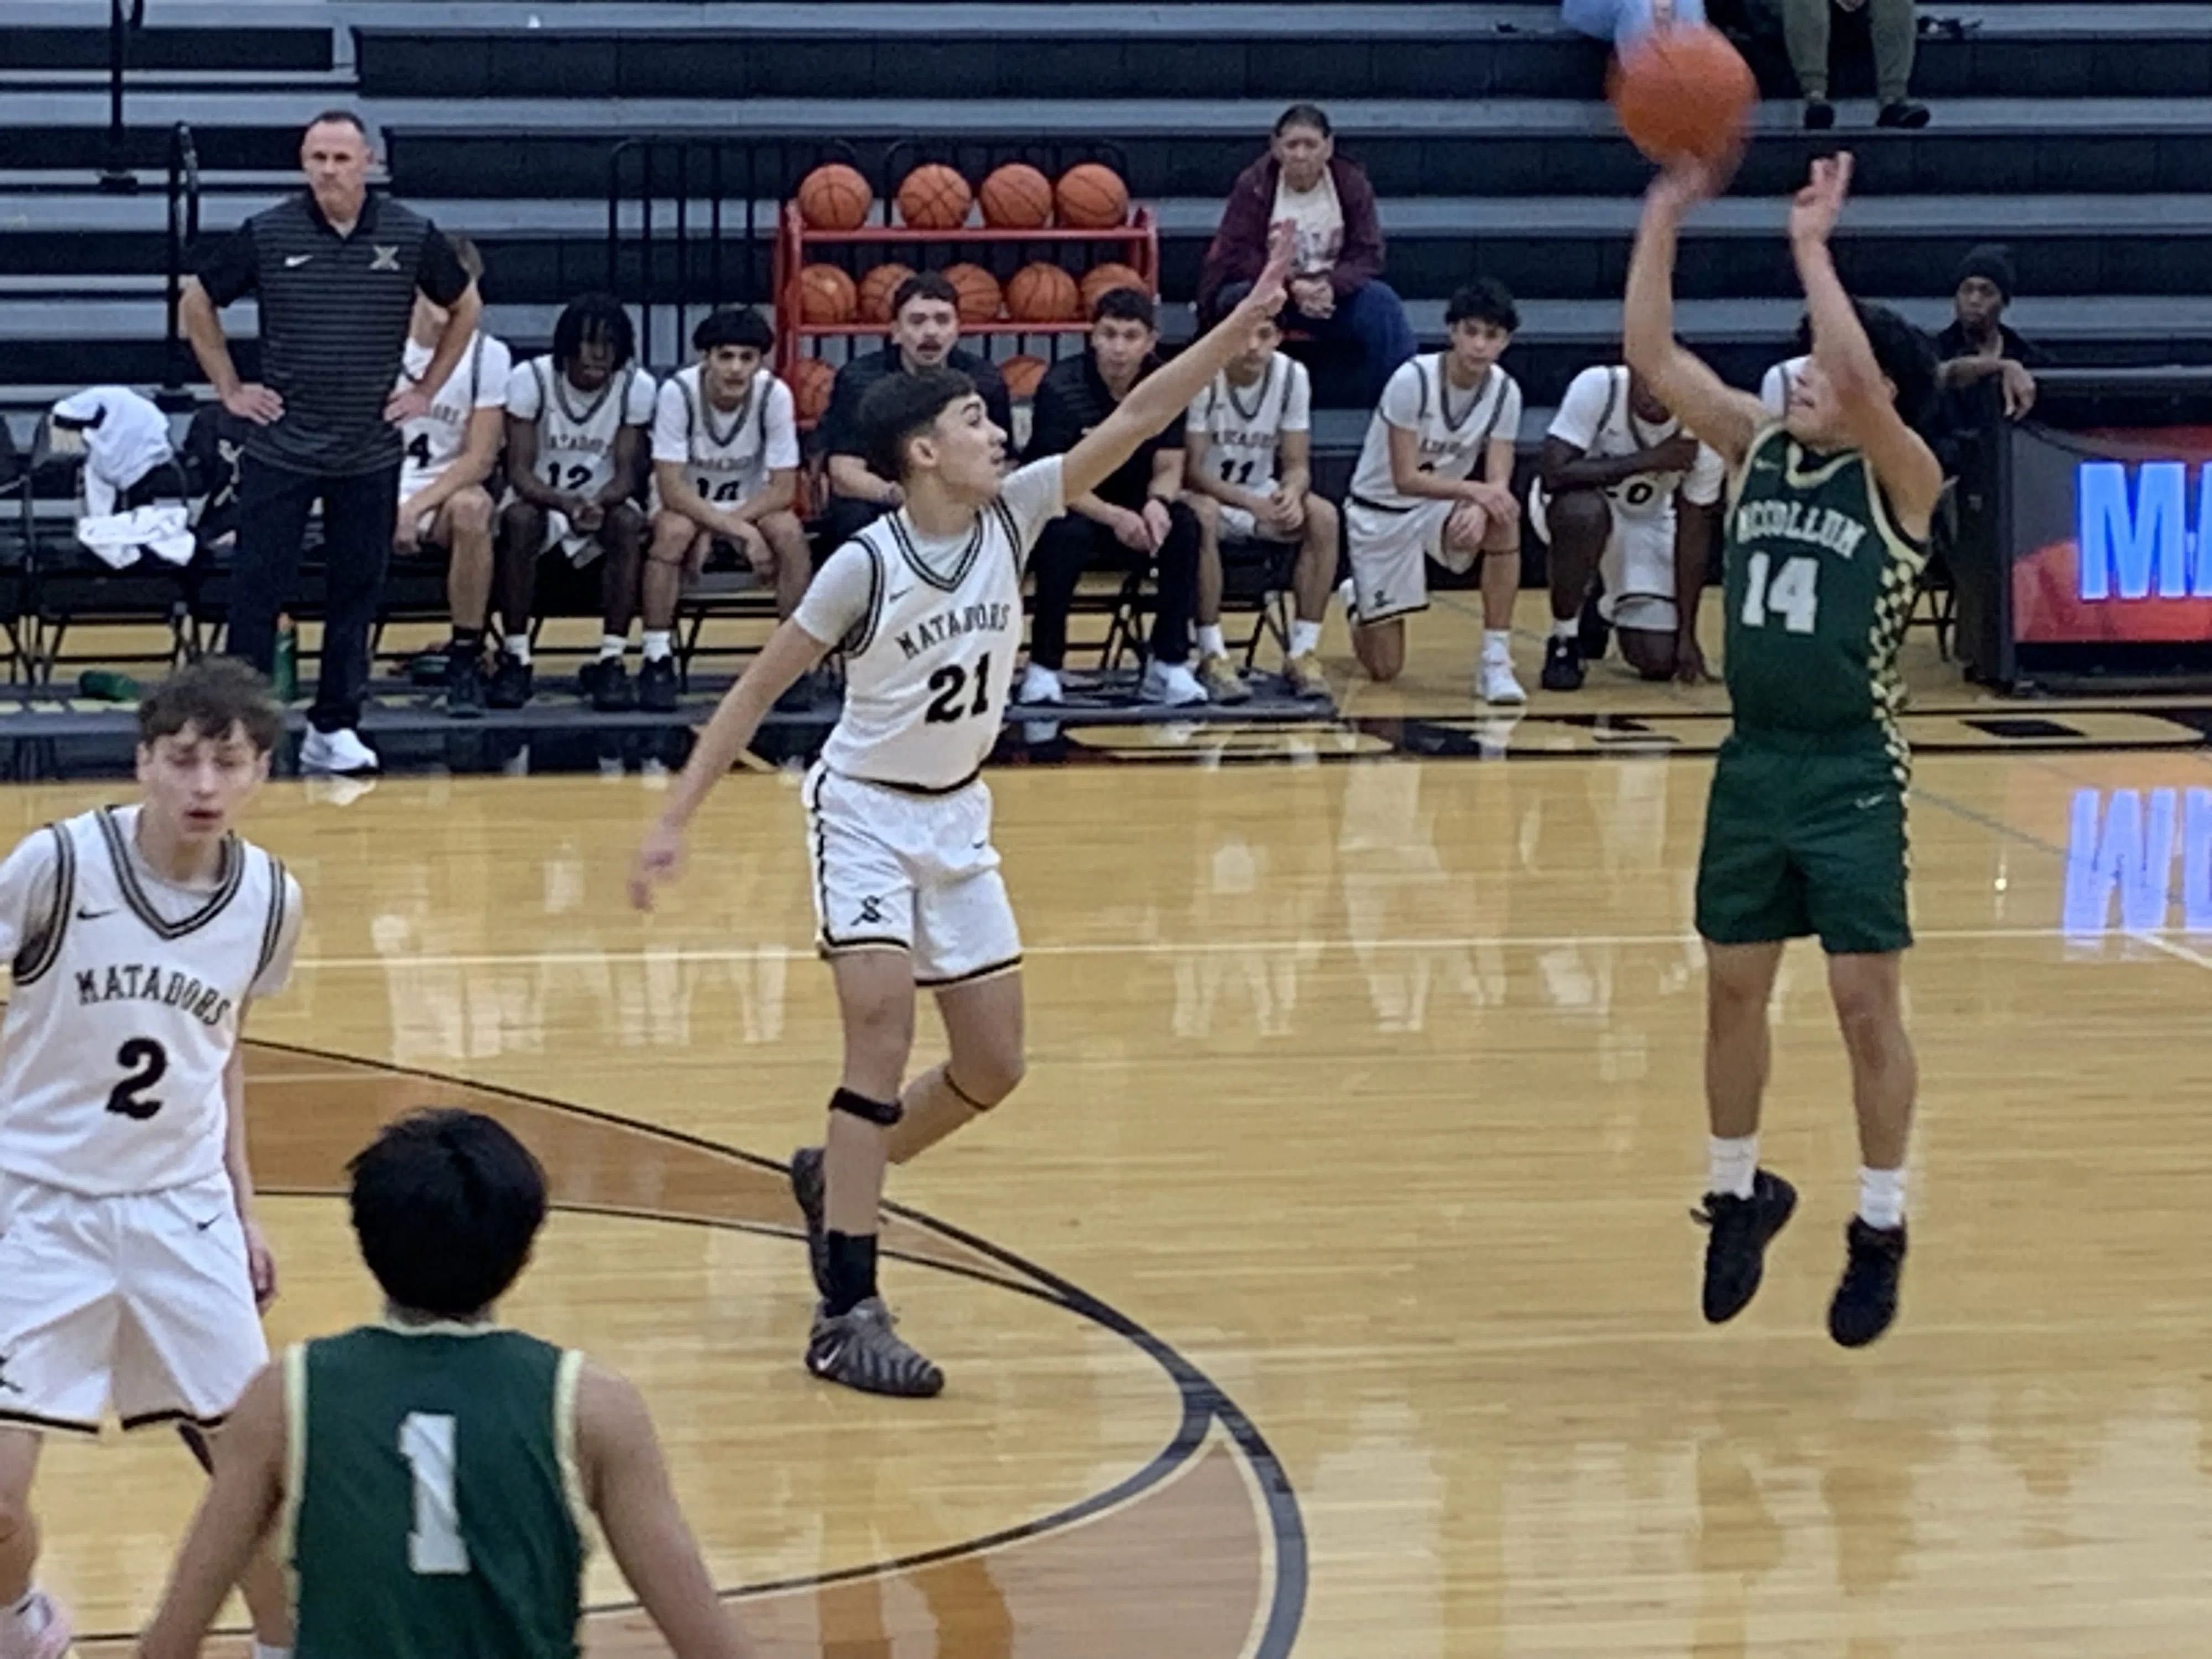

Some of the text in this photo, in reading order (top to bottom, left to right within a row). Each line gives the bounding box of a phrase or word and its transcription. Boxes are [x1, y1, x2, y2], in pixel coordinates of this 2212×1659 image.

[408, 432, 432, 468] 4
[549, 461, 593, 489] 12
[2080, 461, 2212, 599] M
[1741, 551, 1819, 634] 14
[894, 603, 1011, 660] MATADORS
[925, 650, 991, 723] 21
[75, 963, 231, 1026] MATADORS
[105, 1036, 169, 1121] 2
[398, 1410, 471, 1575] 1
